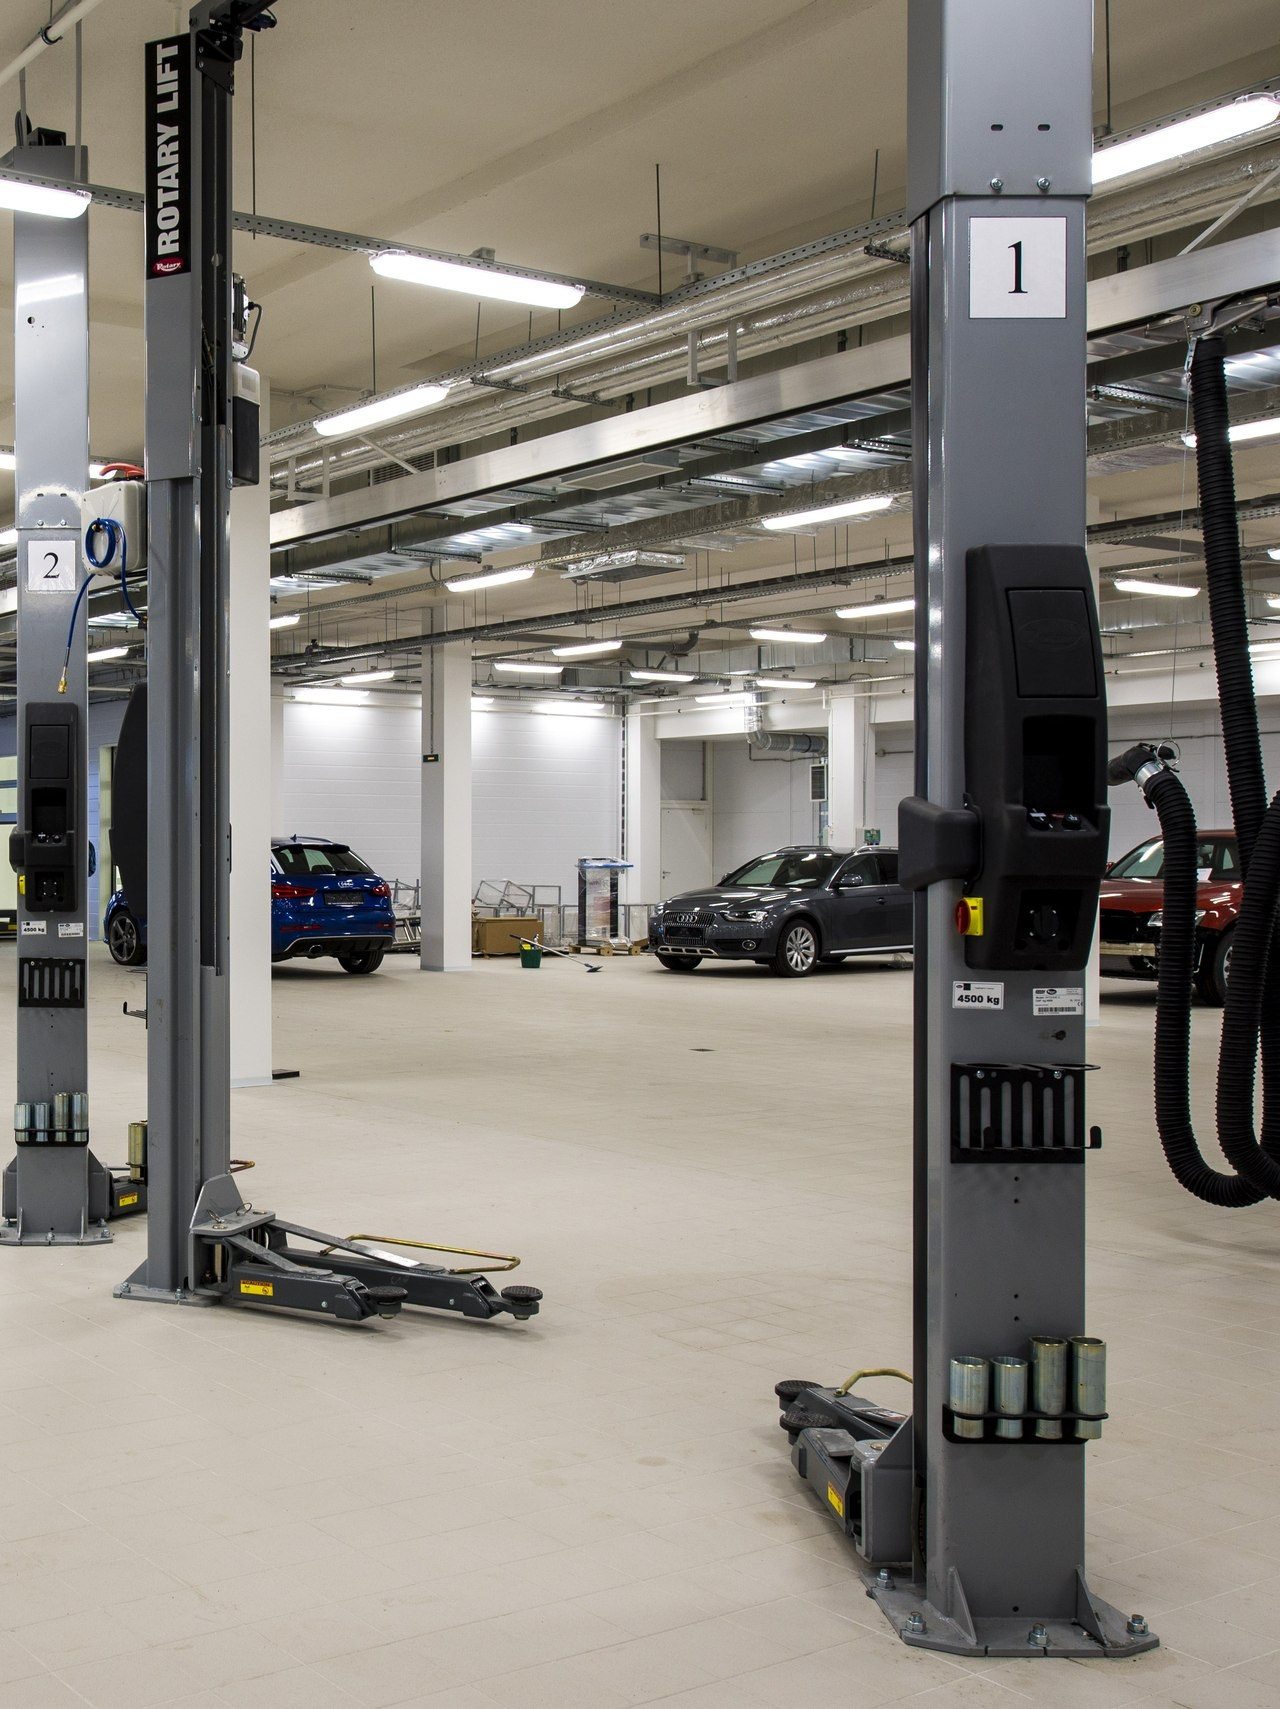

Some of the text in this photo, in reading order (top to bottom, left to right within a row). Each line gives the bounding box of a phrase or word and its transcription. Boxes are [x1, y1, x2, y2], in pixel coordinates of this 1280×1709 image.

[157, 43, 180, 255] ROTARY LIFT
[156, 262, 181, 272] Rotary
[1007, 240, 1029, 293] 1
[43, 552, 60, 579] 2
[957, 995, 1000, 1006] 4500 kg
